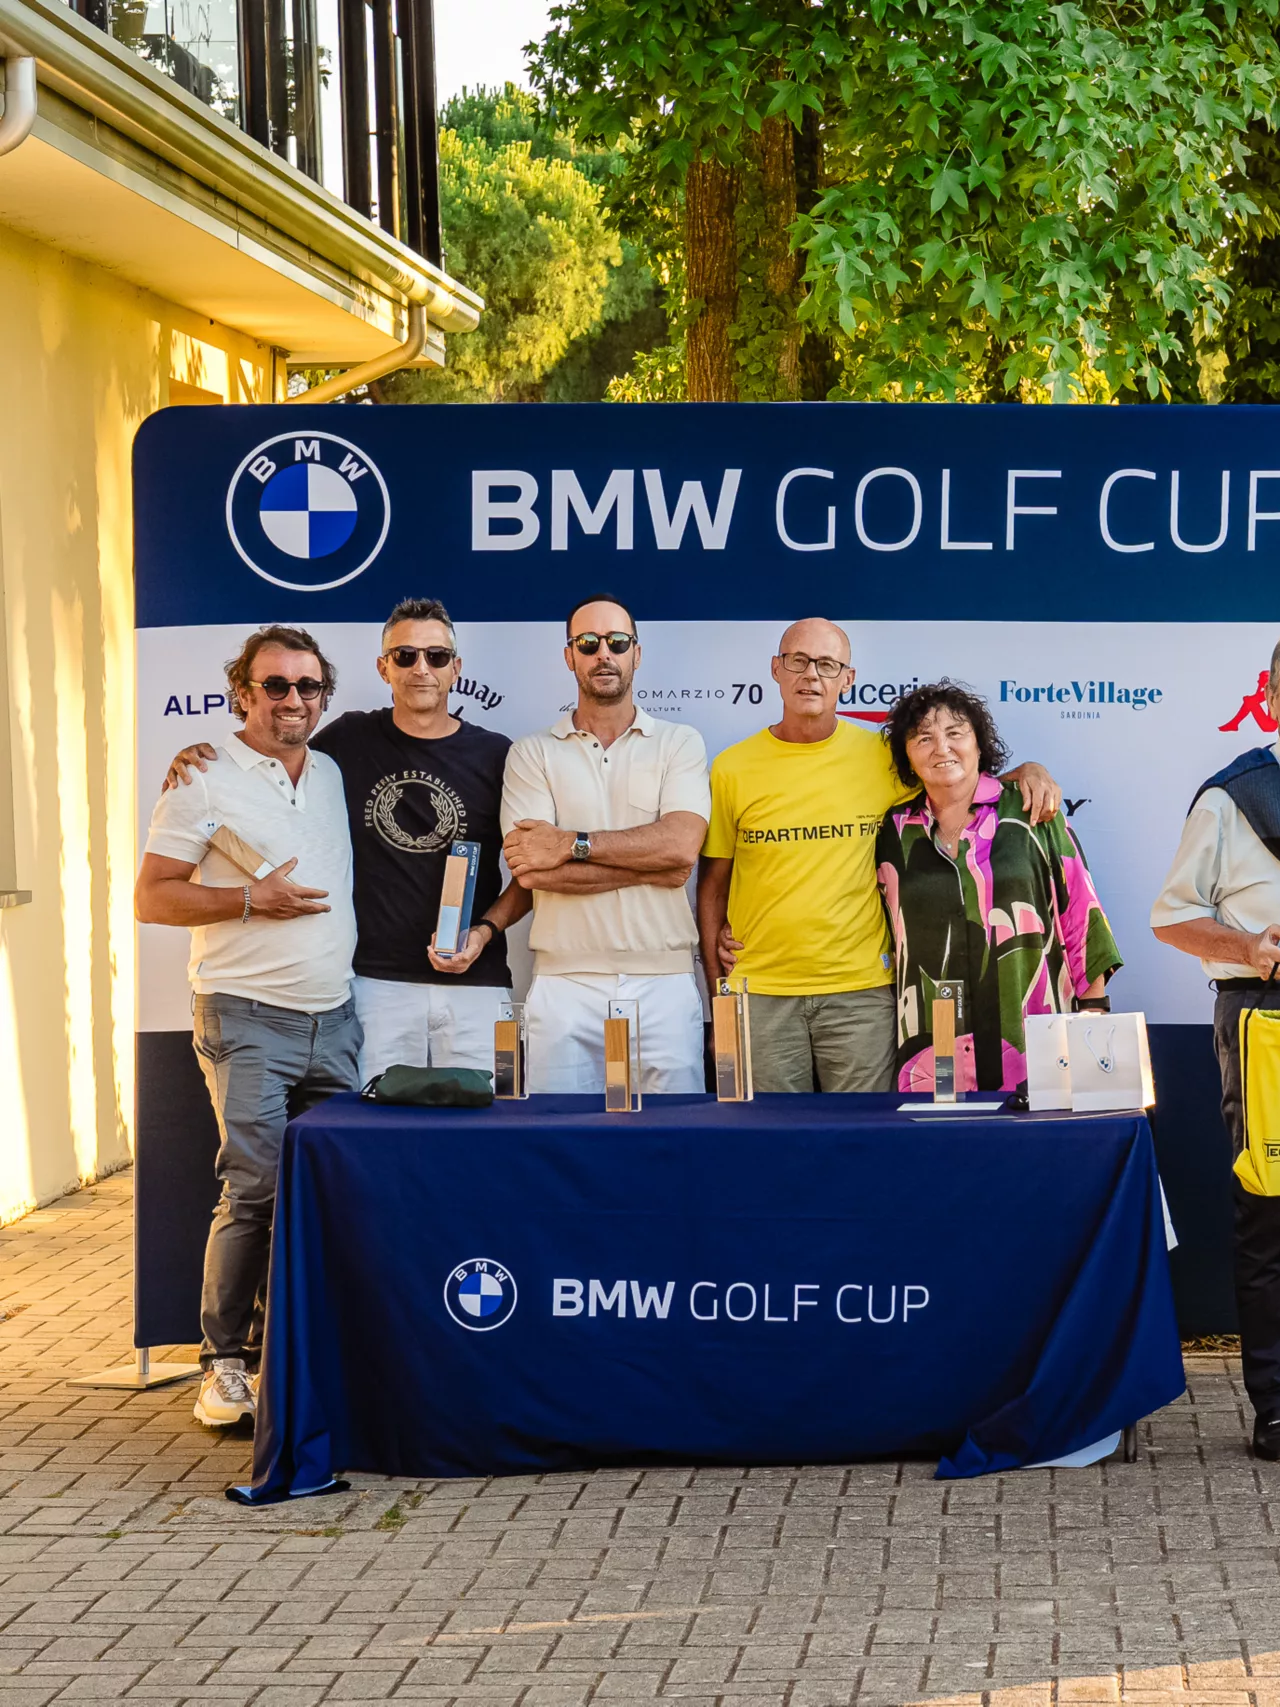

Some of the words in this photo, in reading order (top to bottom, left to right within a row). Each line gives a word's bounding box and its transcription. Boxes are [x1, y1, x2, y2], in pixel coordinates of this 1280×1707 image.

[248, 440, 368, 484] BMW
[472, 469, 742, 551] BMW
[775, 467, 1062, 552] GOLF
[637, 689, 725, 699] OMARZIO
[731, 684, 763, 705] 70
[1060, 711, 1101, 719] SARDINIA
[364, 799, 374, 827] FRED
[403, 770, 467, 817] ESTABLISHED
[743, 824, 854, 844] DEPARTMENT
[454, 1262, 508, 1282] BMW
[553, 1278, 676, 1319] BMW
[690, 1281, 820, 1322] GOLF
[836, 1284, 929, 1323] CUP
